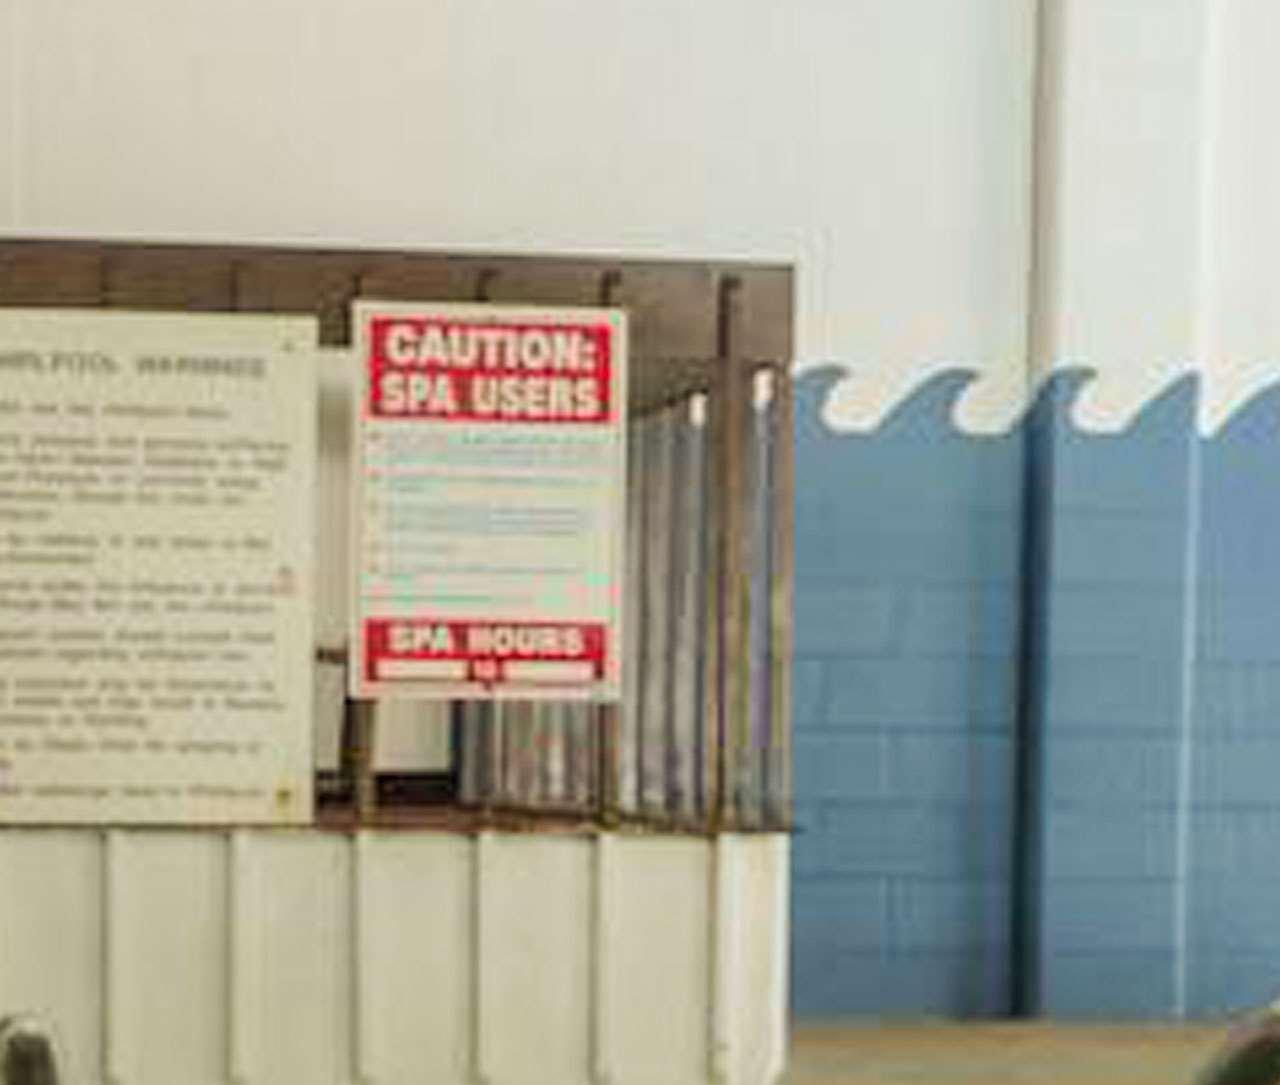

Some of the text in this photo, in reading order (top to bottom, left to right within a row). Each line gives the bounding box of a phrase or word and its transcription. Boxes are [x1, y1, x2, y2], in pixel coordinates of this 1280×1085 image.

[383, 323, 596, 372] CAUTION:
[380, 371, 601, 418] SPA USERS
[389, 622, 585, 658] SPA HOURS
